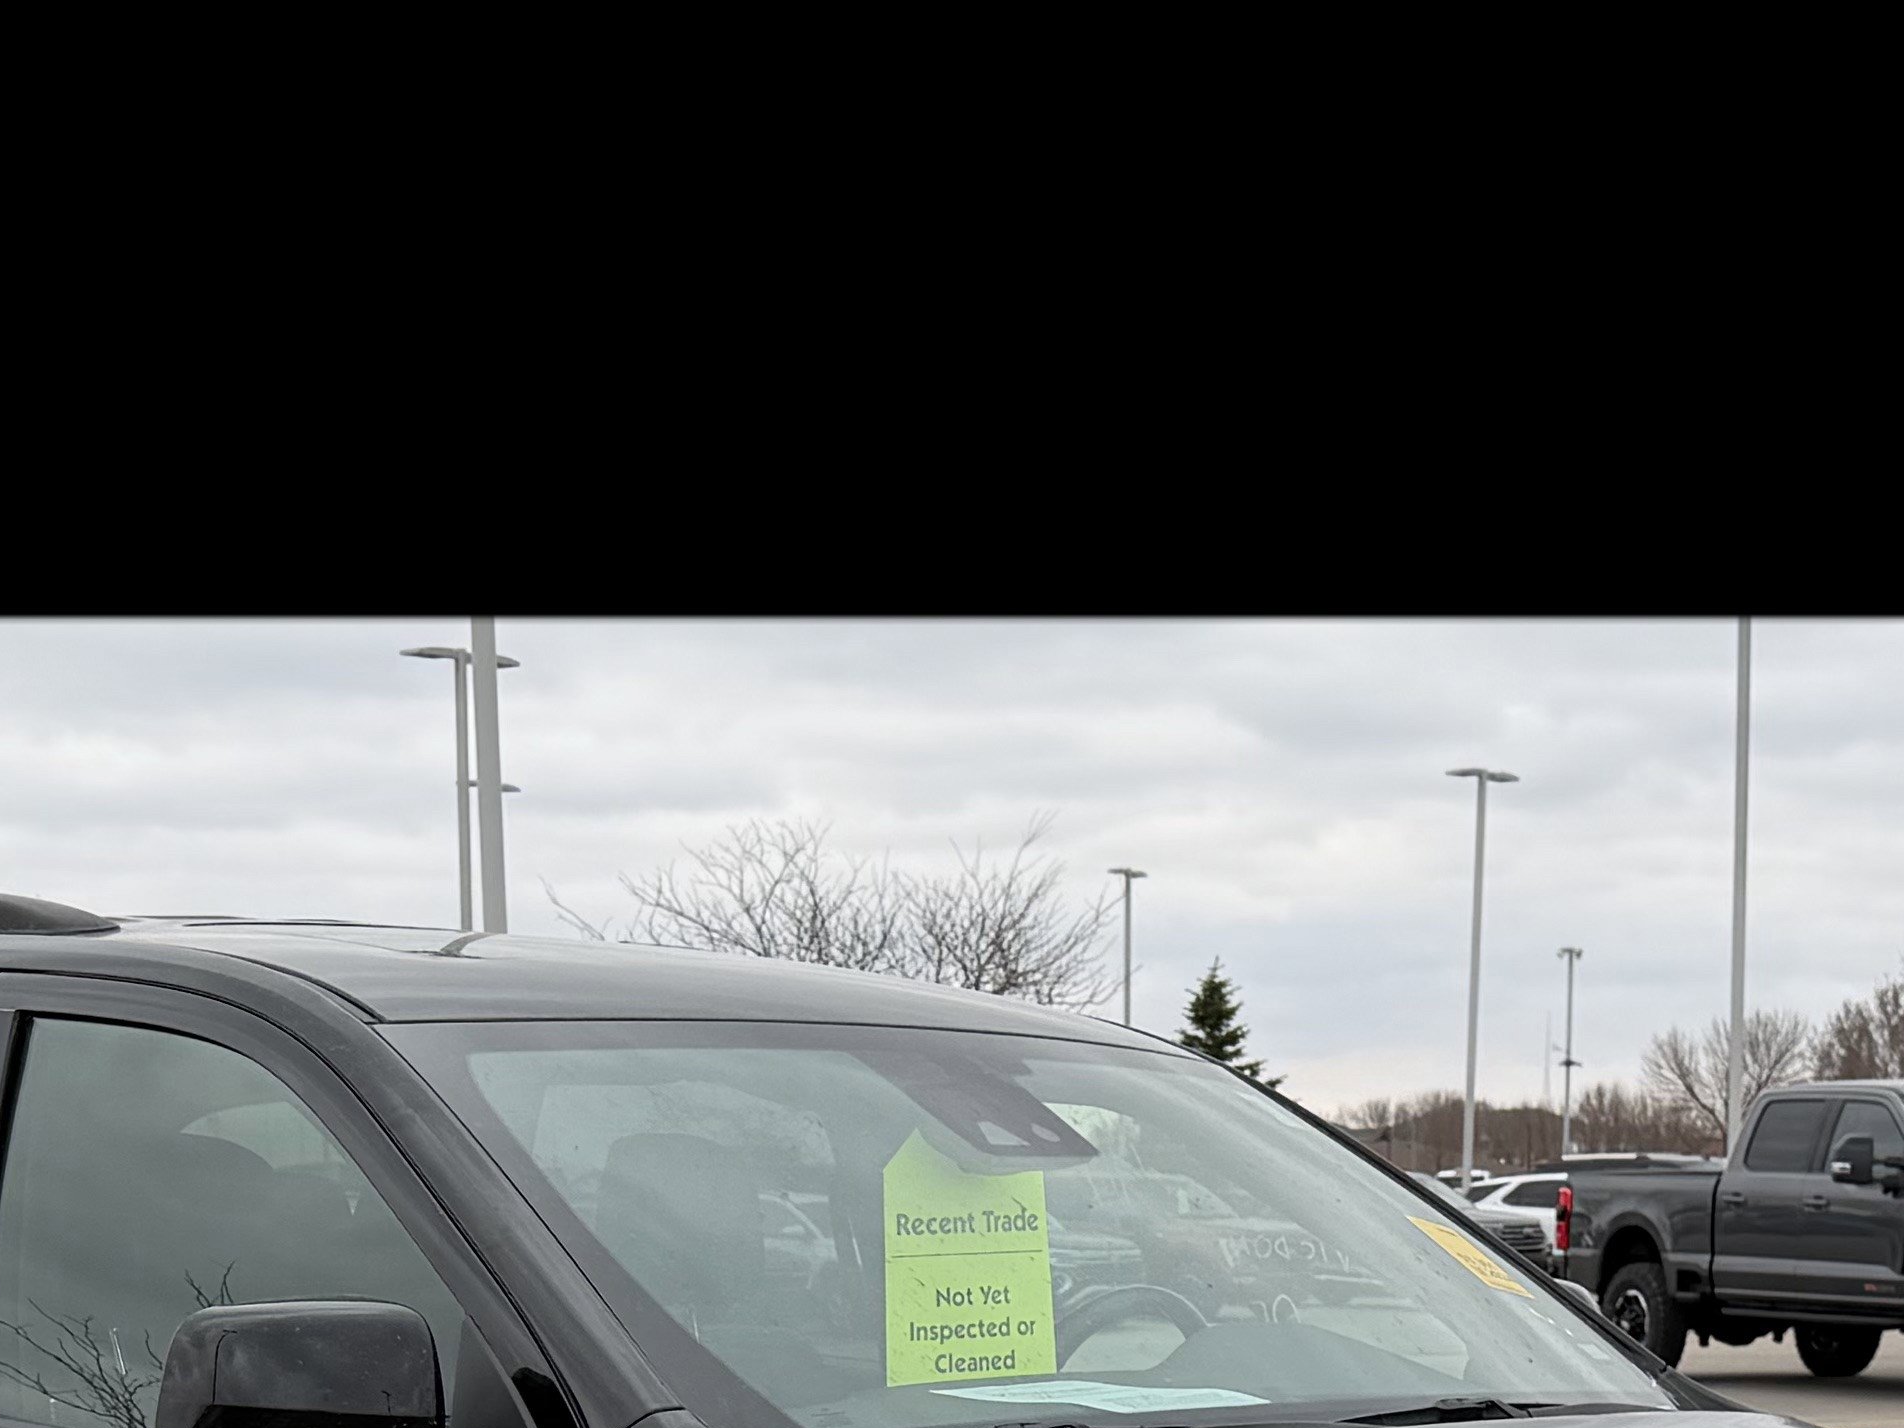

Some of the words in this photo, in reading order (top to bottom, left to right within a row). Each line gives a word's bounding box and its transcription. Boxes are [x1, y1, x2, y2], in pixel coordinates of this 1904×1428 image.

[896, 1212, 976, 1236] Recent
[982, 1208, 1039, 1233] Trade
[936, 1287, 973, 1307] Not
[980, 1285, 1011, 1305] Yet
[909, 1316, 1011, 1345] Inspected
[1017, 1320, 1036, 1335] or
[934, 1349, 1016, 1373] Cleaned
